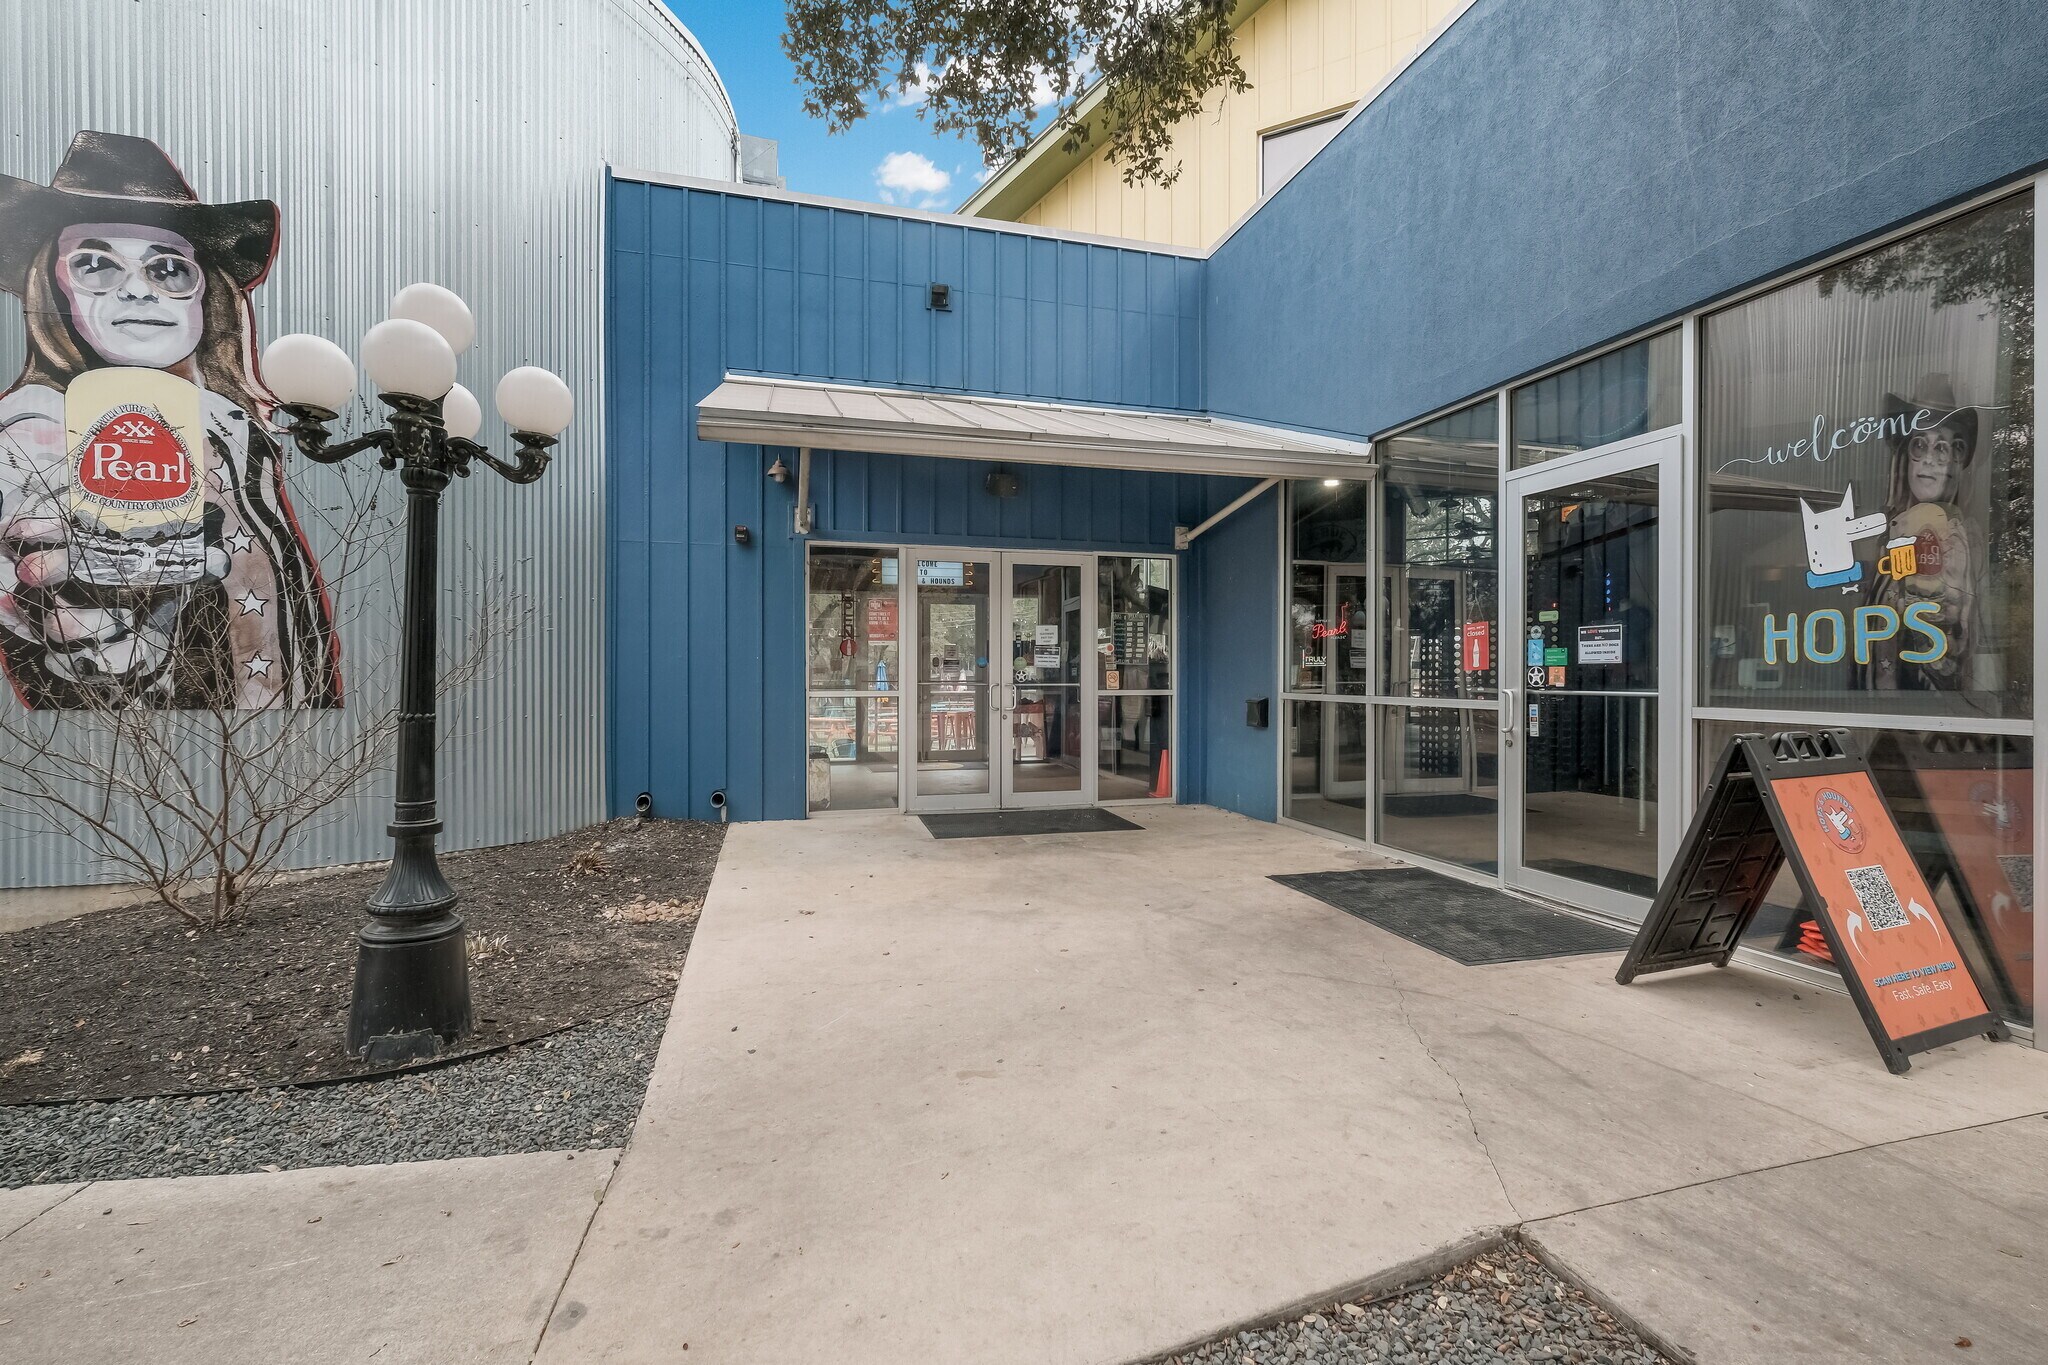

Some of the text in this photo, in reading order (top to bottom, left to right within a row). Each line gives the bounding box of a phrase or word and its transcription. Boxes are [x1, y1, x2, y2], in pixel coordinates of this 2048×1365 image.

[119, 403, 147, 415] PURE
[92, 443, 187, 484] Pearl
[99, 497, 146, 510] COUNTRY
[917, 560, 938, 568] LCOME
[930, 577, 955, 585] HOUNDS
[1312, 620, 1348, 639] Pearl
[1466, 629, 1485, 637] closed
[1763, 600, 1948, 665] HOPS
[1821, 791, 1855, 813] HOUNDS
[1873, 960, 1957, 987] SCAN HERE TO VIEW MENU
[1892, 980, 1953, 1002] Fast, Safe, Easy
